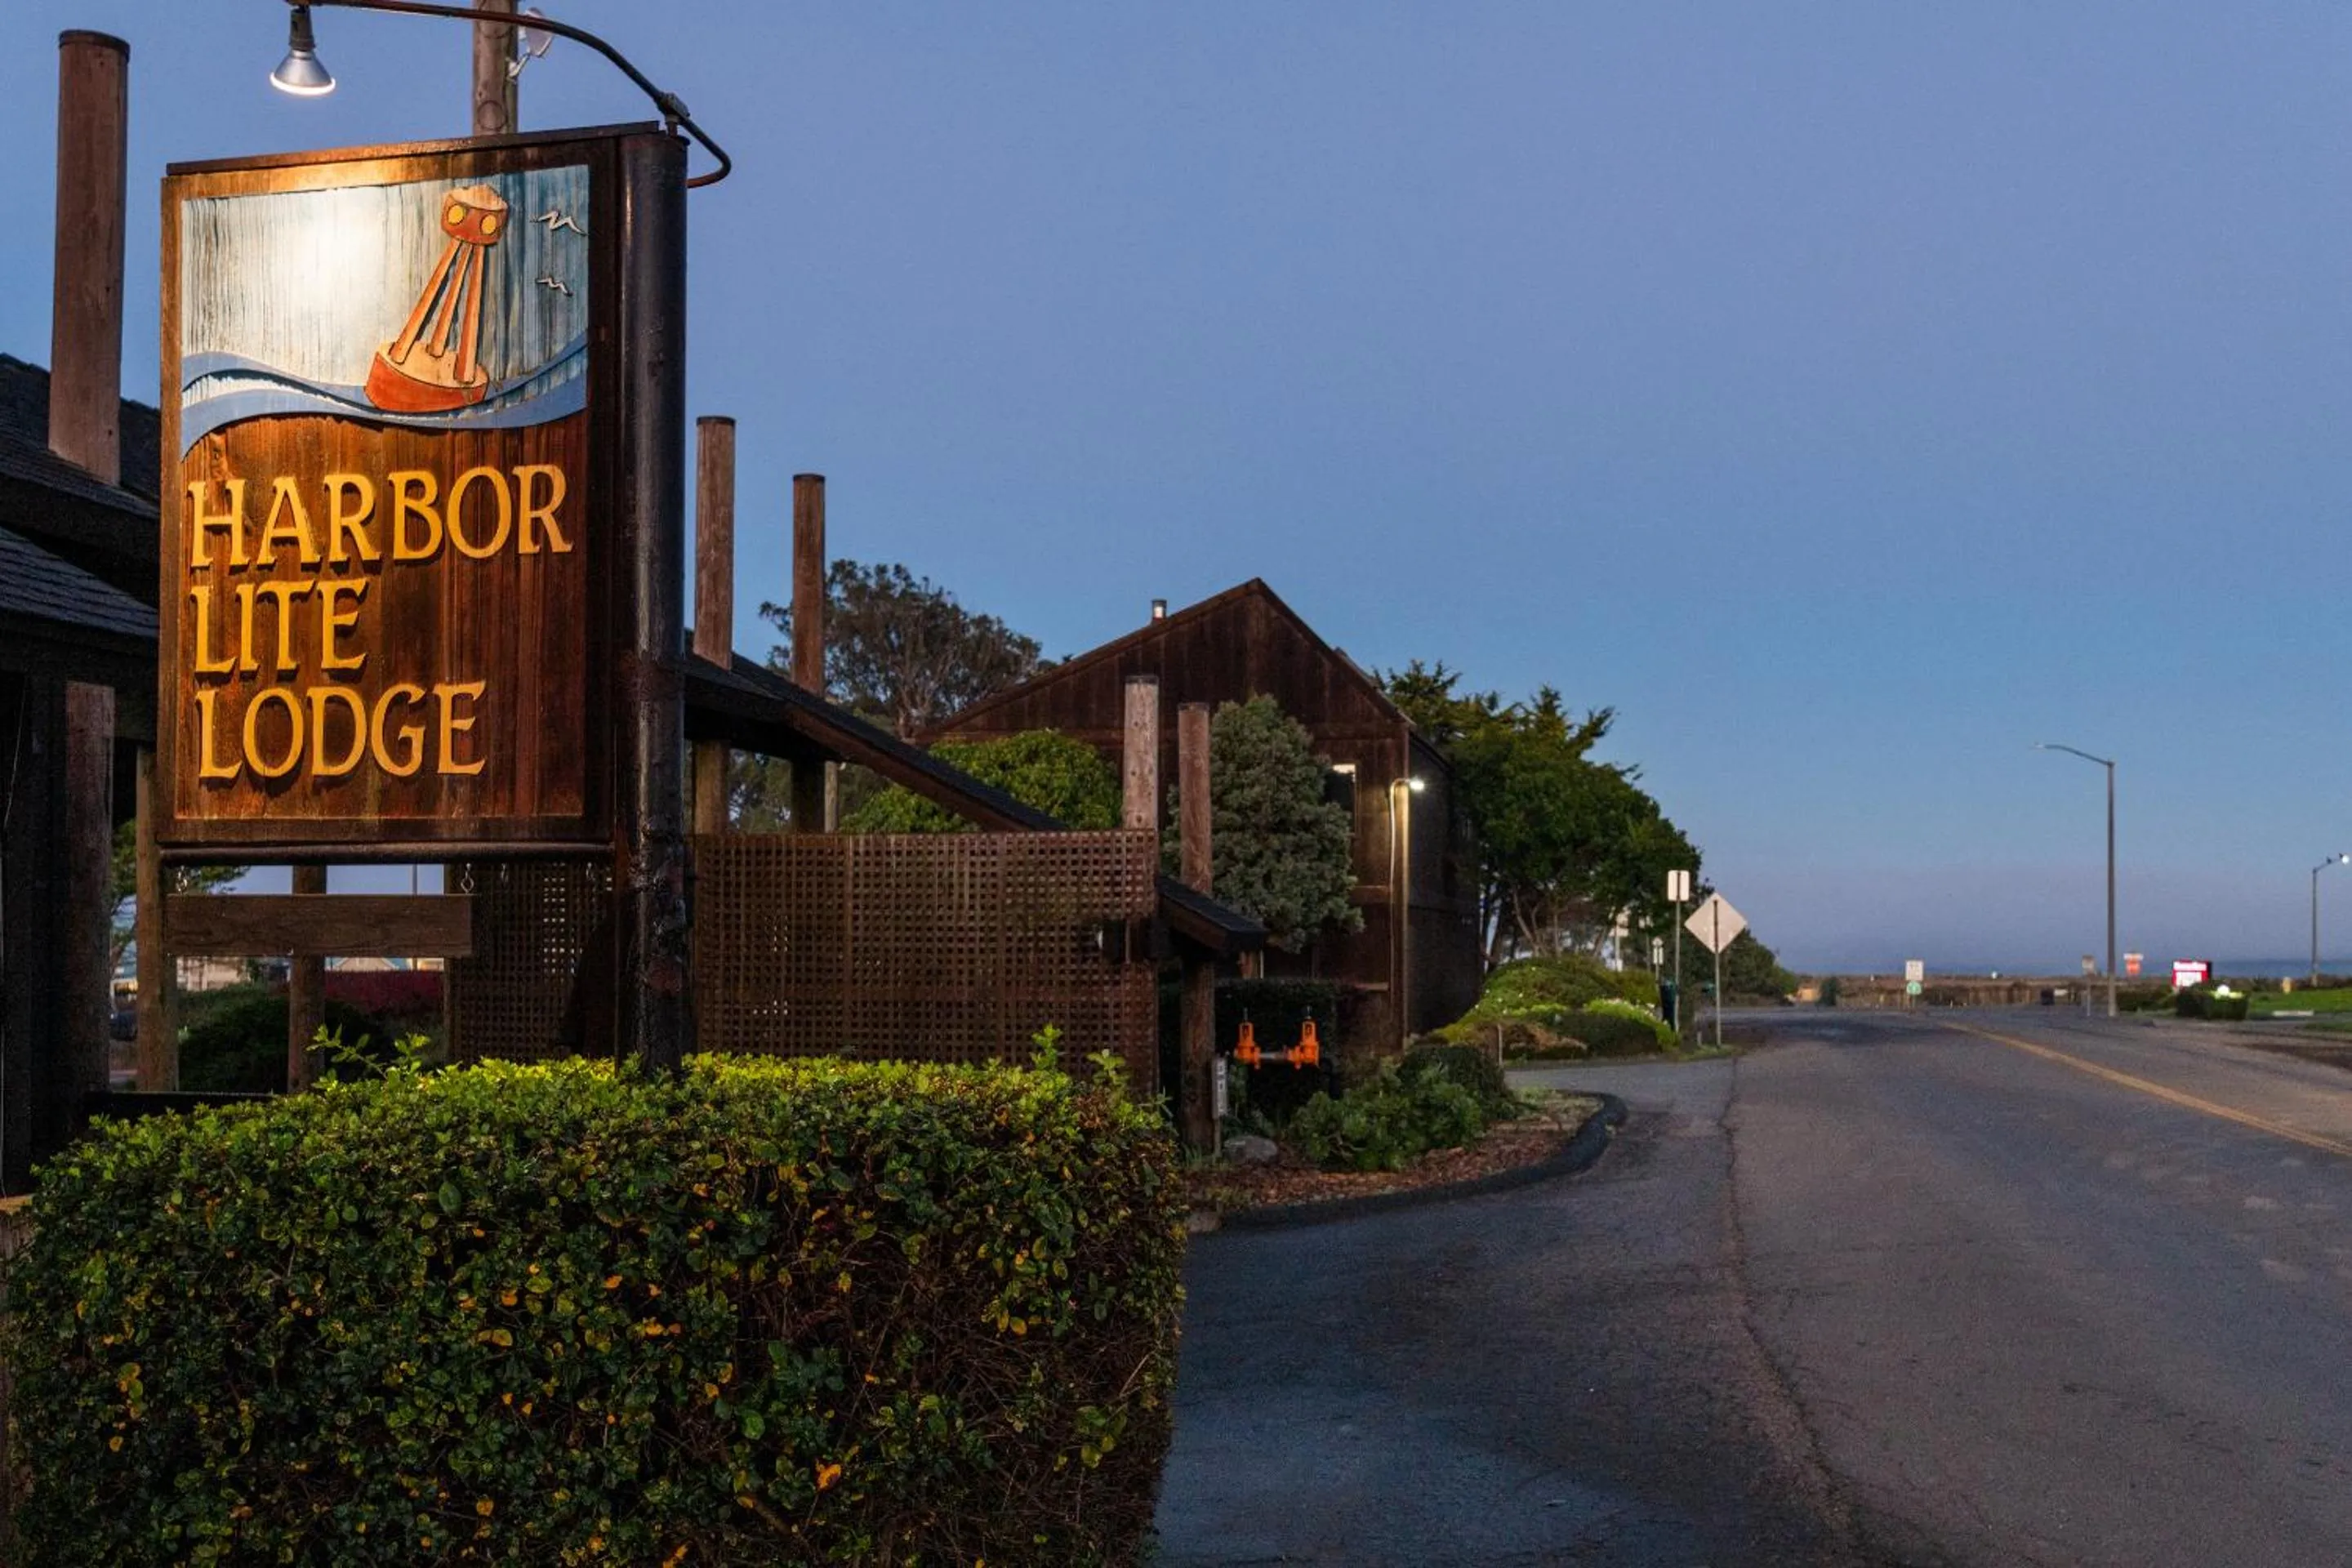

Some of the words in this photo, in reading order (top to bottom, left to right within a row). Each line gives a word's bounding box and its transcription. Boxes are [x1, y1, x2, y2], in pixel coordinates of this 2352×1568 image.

[187, 465, 572, 569] HARBOR
[189, 577, 369, 674] LITE
[195, 679, 487, 779] LODGE
